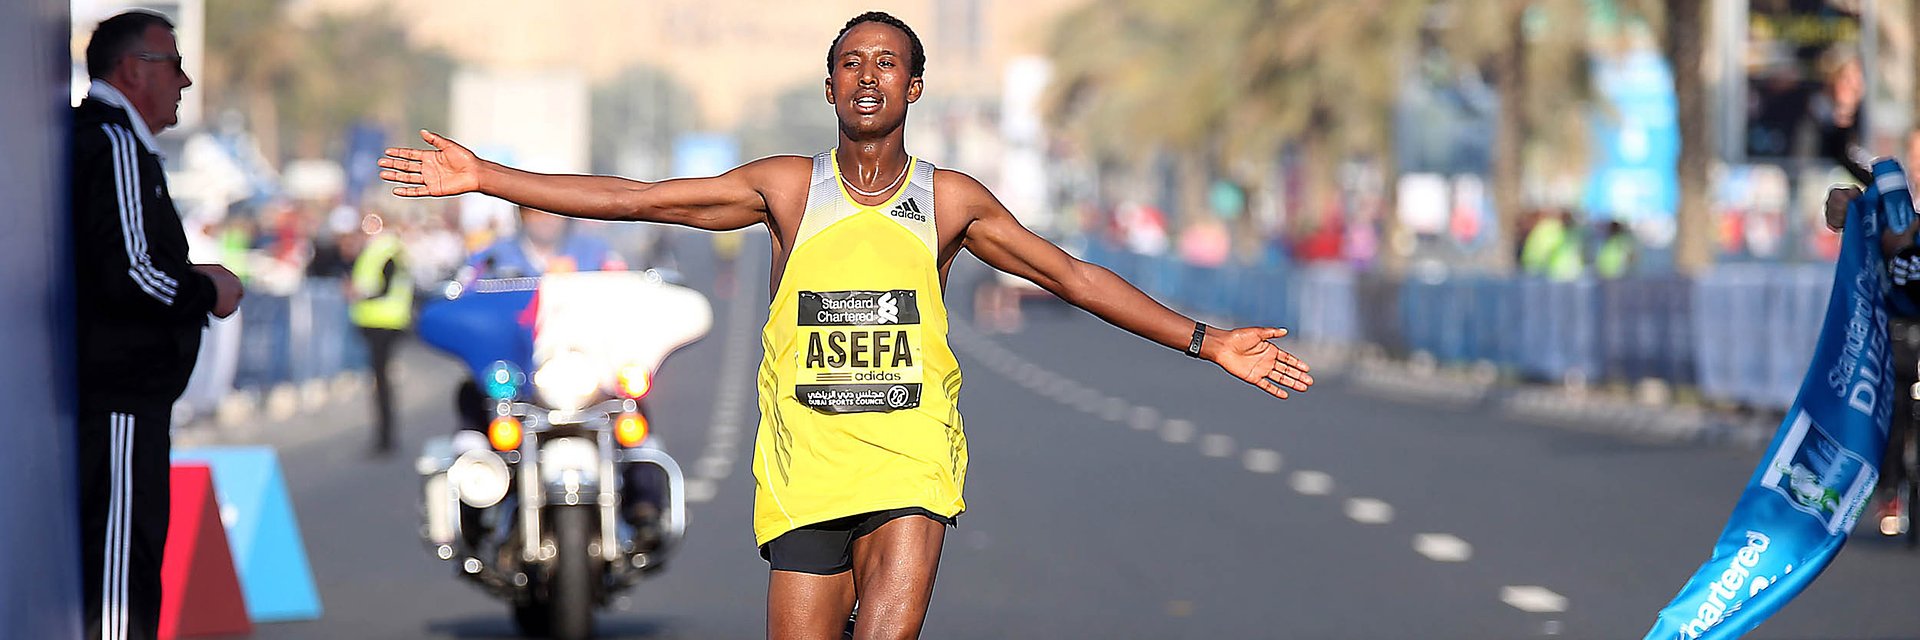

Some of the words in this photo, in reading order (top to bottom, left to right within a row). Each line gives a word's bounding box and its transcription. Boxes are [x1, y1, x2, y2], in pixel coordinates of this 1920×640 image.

[890, 209, 926, 222] adidas
[821, 297, 874, 309] Standard
[817, 310, 874, 322] Chartered
[806, 331, 913, 369] ASEFA
[855, 371, 901, 381] adidas
[1676, 530, 1771, 640] hartered
